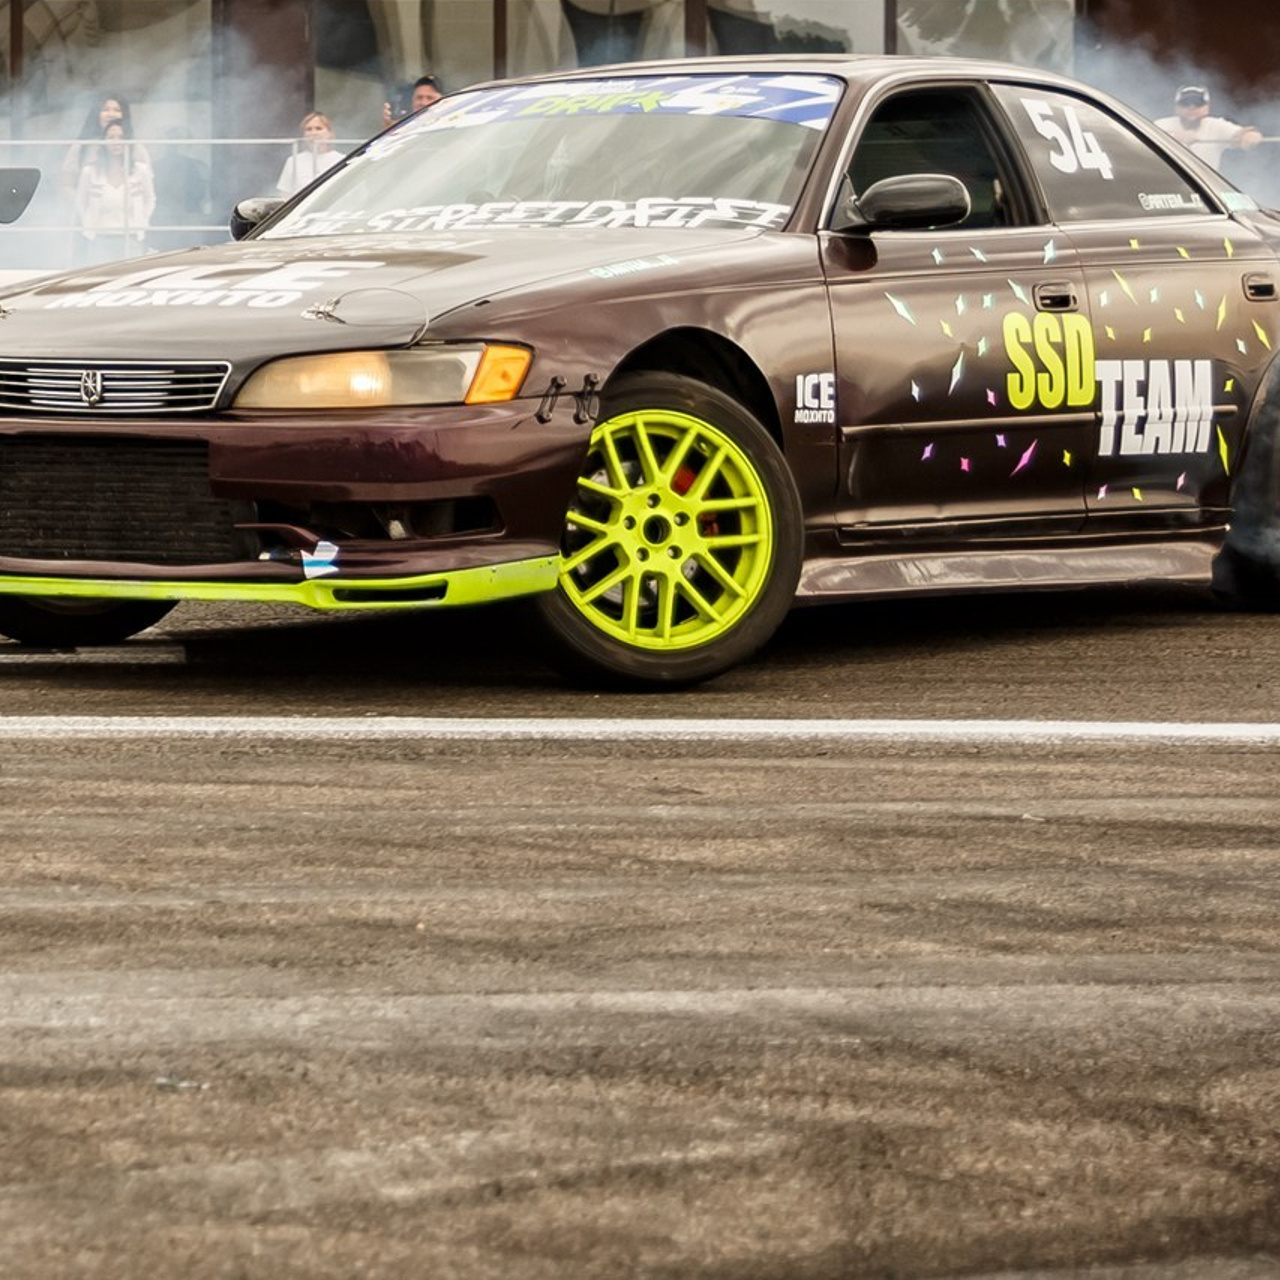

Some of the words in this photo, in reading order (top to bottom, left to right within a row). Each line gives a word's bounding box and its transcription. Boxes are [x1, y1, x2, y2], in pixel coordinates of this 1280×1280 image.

[514, 91, 669, 117] DRIFT
[1020, 98, 1114, 180] 54
[796, 373, 835, 409] ICE
[1002, 311, 1096, 410] SSD
[1094, 359, 1213, 457] TEAM
